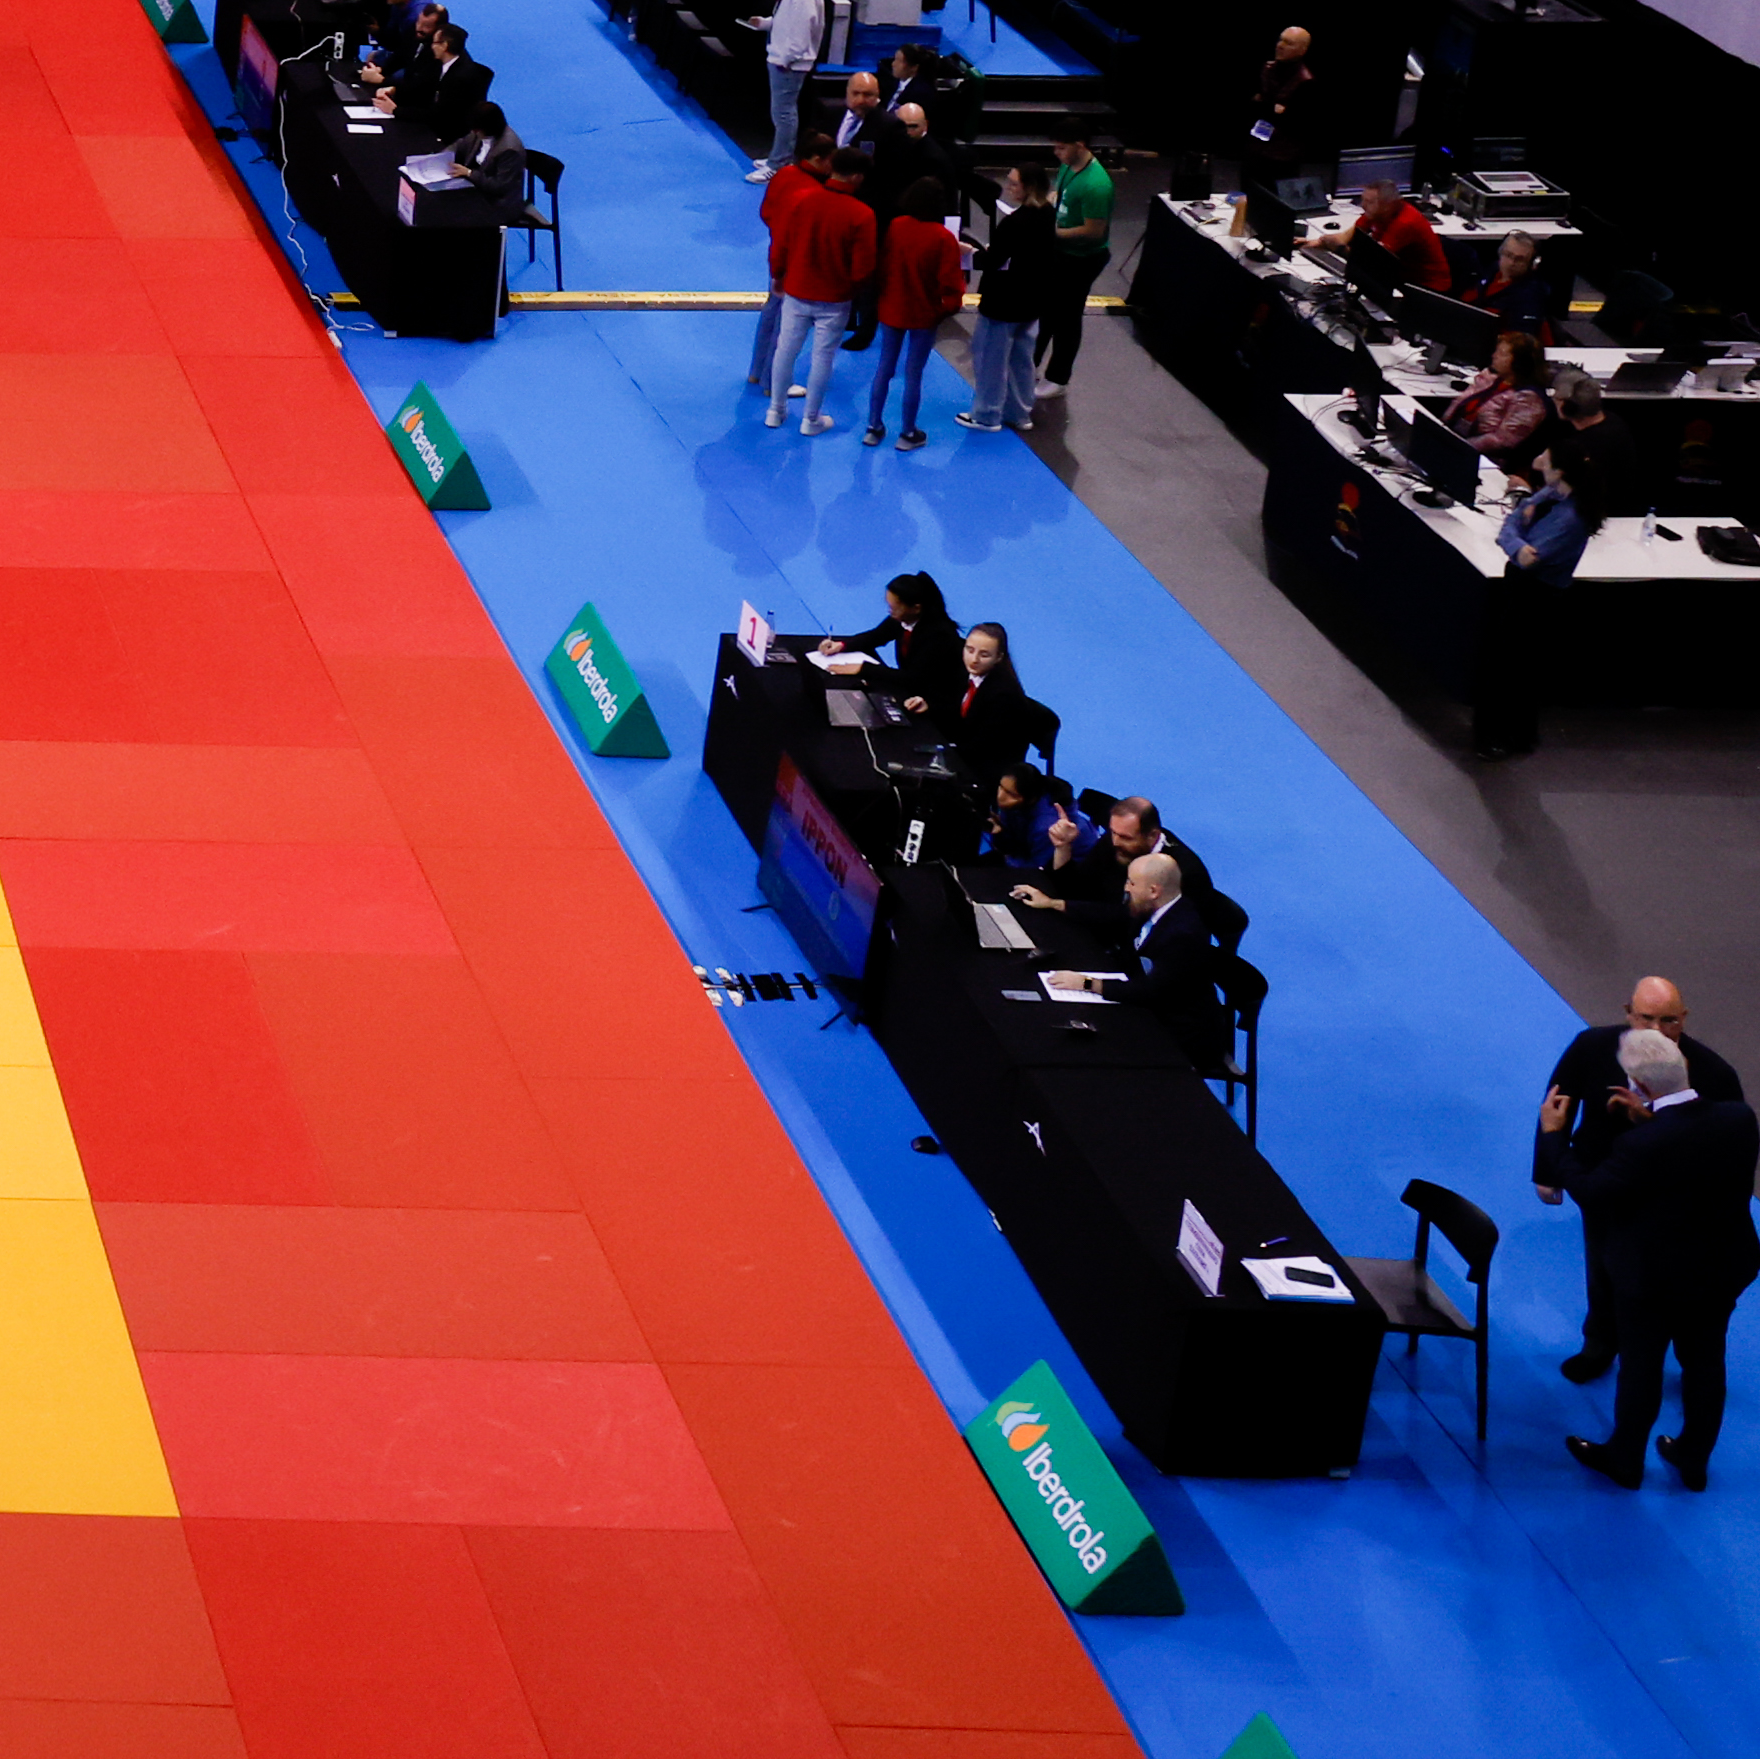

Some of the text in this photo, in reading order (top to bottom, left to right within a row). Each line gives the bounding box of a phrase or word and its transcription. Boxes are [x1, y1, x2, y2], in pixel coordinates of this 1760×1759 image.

[409, 419, 445, 483] Iberdrola
[745, 616, 758, 651] 1
[576, 648, 619, 724] Iberdrola
[1021, 1440, 1108, 1575] Iberdrola
